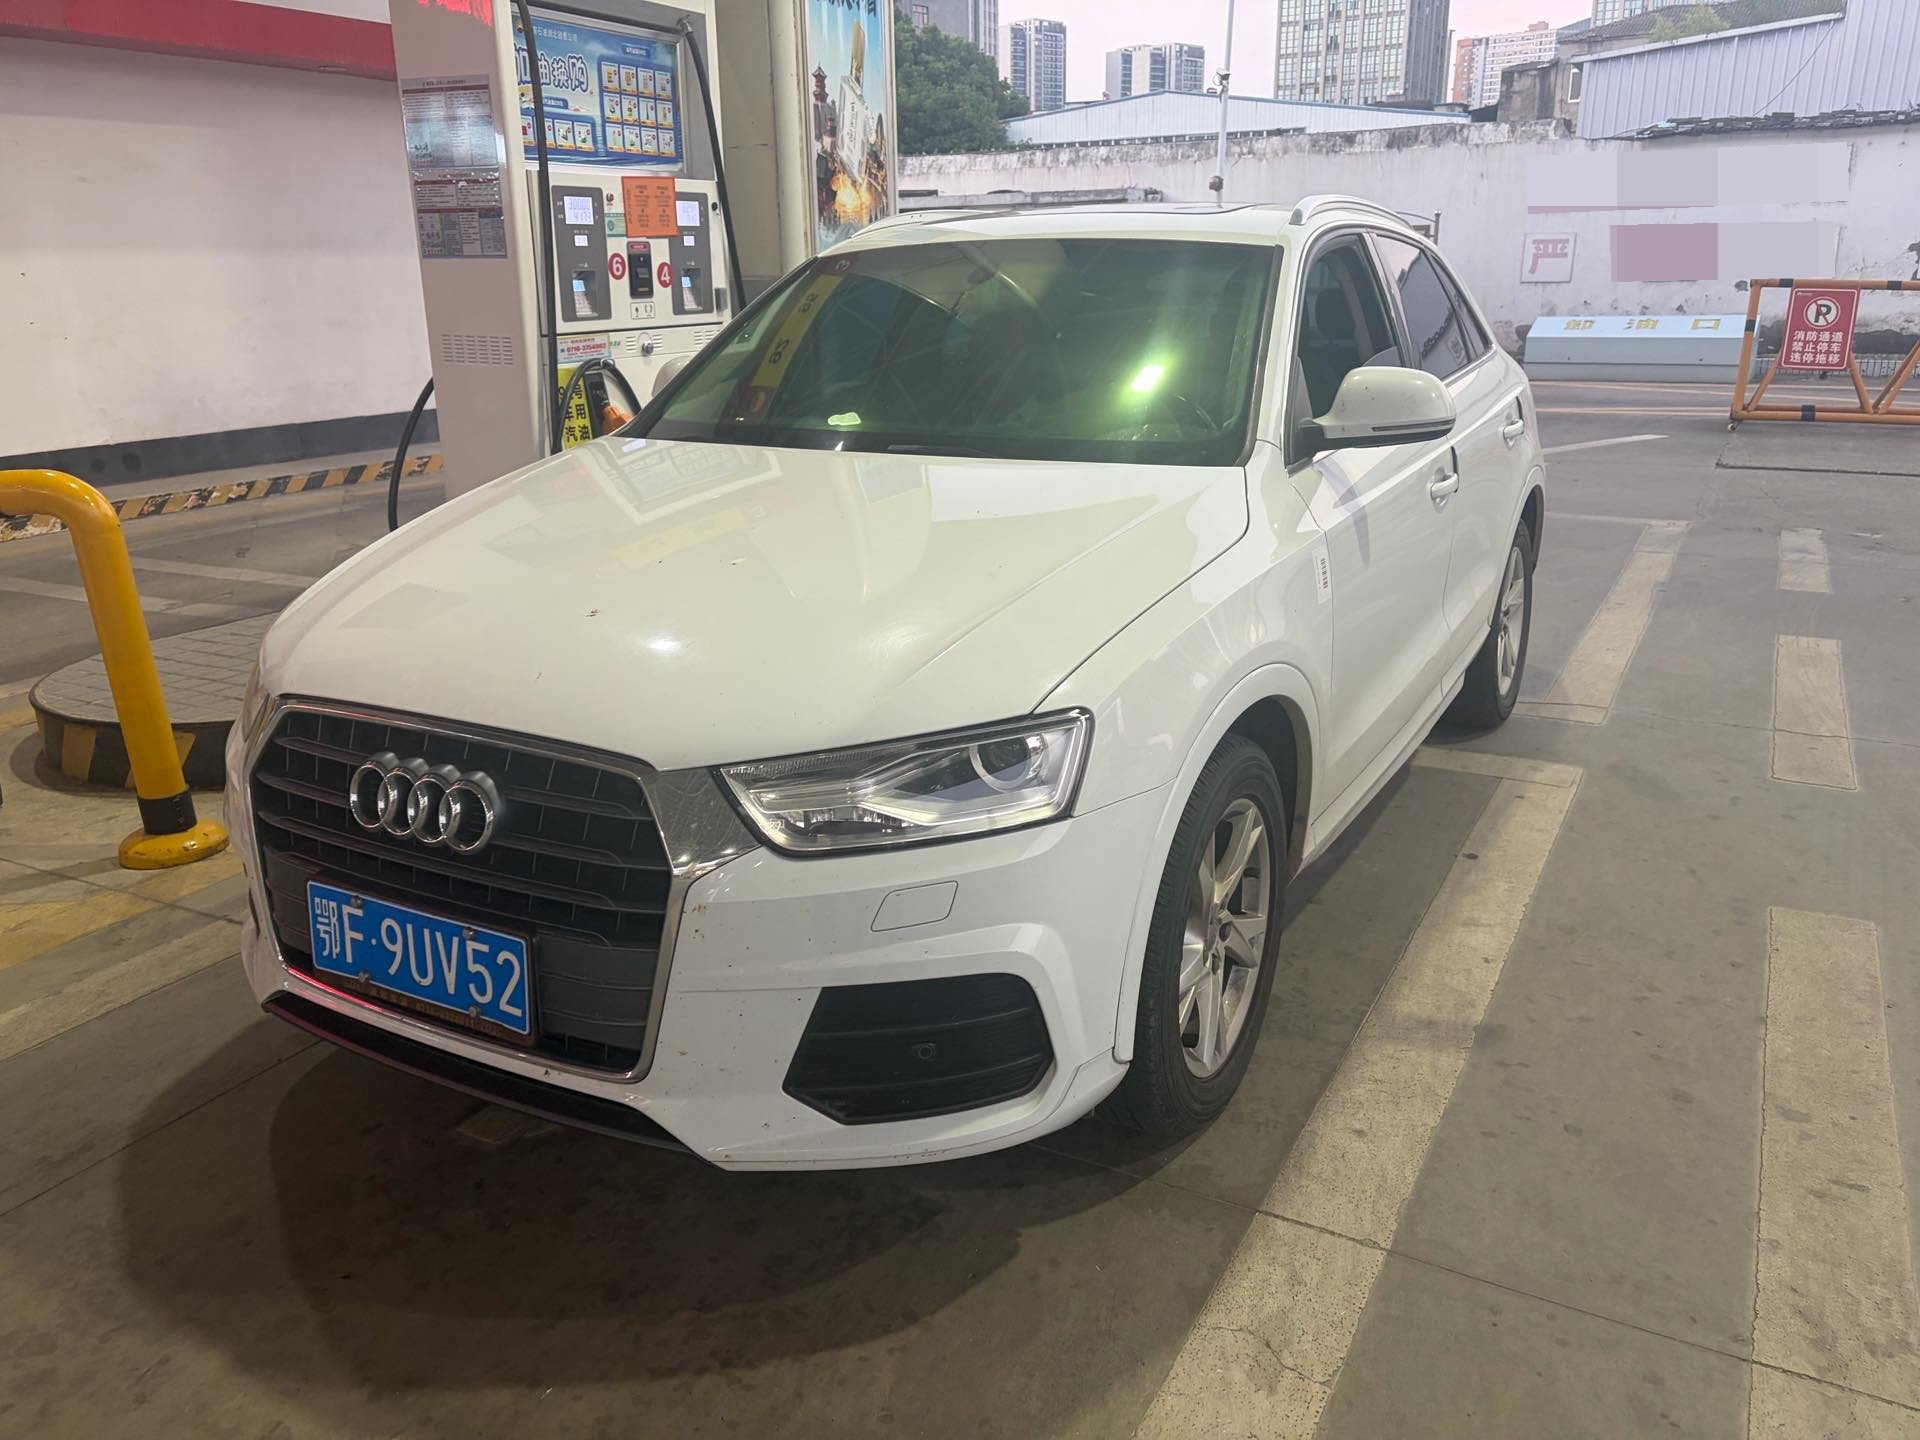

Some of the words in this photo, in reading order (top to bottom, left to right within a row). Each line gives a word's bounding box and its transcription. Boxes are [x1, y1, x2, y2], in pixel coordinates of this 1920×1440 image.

[612, 256, 623, 276] 6
[1528, 238, 1570, 275] 严
[660, 264, 670, 283] 4
[1793, 330, 1843, 342] 消防通道
[1791, 342, 1841, 353] 禁止停车
[565, 423, 591, 443] 汽油
[314, 897, 523, 1018] 鄂F·9UV52
